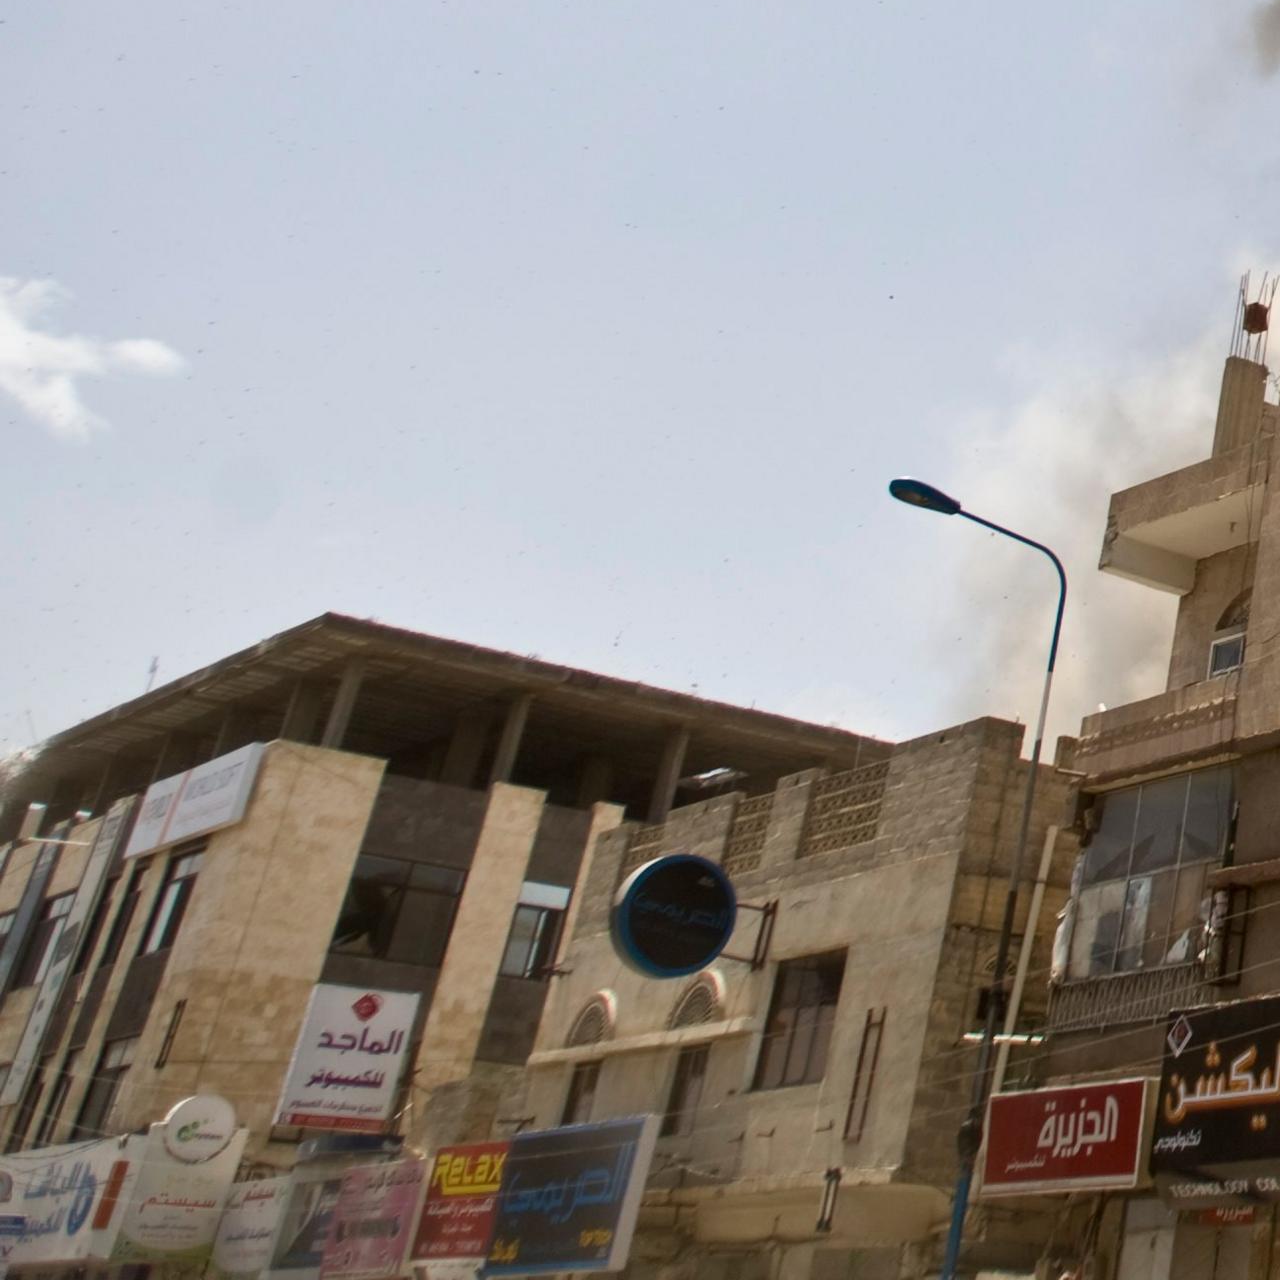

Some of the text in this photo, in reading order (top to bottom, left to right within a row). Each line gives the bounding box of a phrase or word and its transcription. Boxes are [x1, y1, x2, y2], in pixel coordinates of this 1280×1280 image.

[317, 1026, 405, 1056] الماجد
[304, 1068, 386, 1091] للكمبيوتر
[1036, 1094, 1119, 1158] الجزيرة
[1153, 1128, 1202, 1155] تكنولوجي
[1169, 1180, 1250, 1199] TECHNOLOGY
[137, 1192, 218, 1214] سيستم
